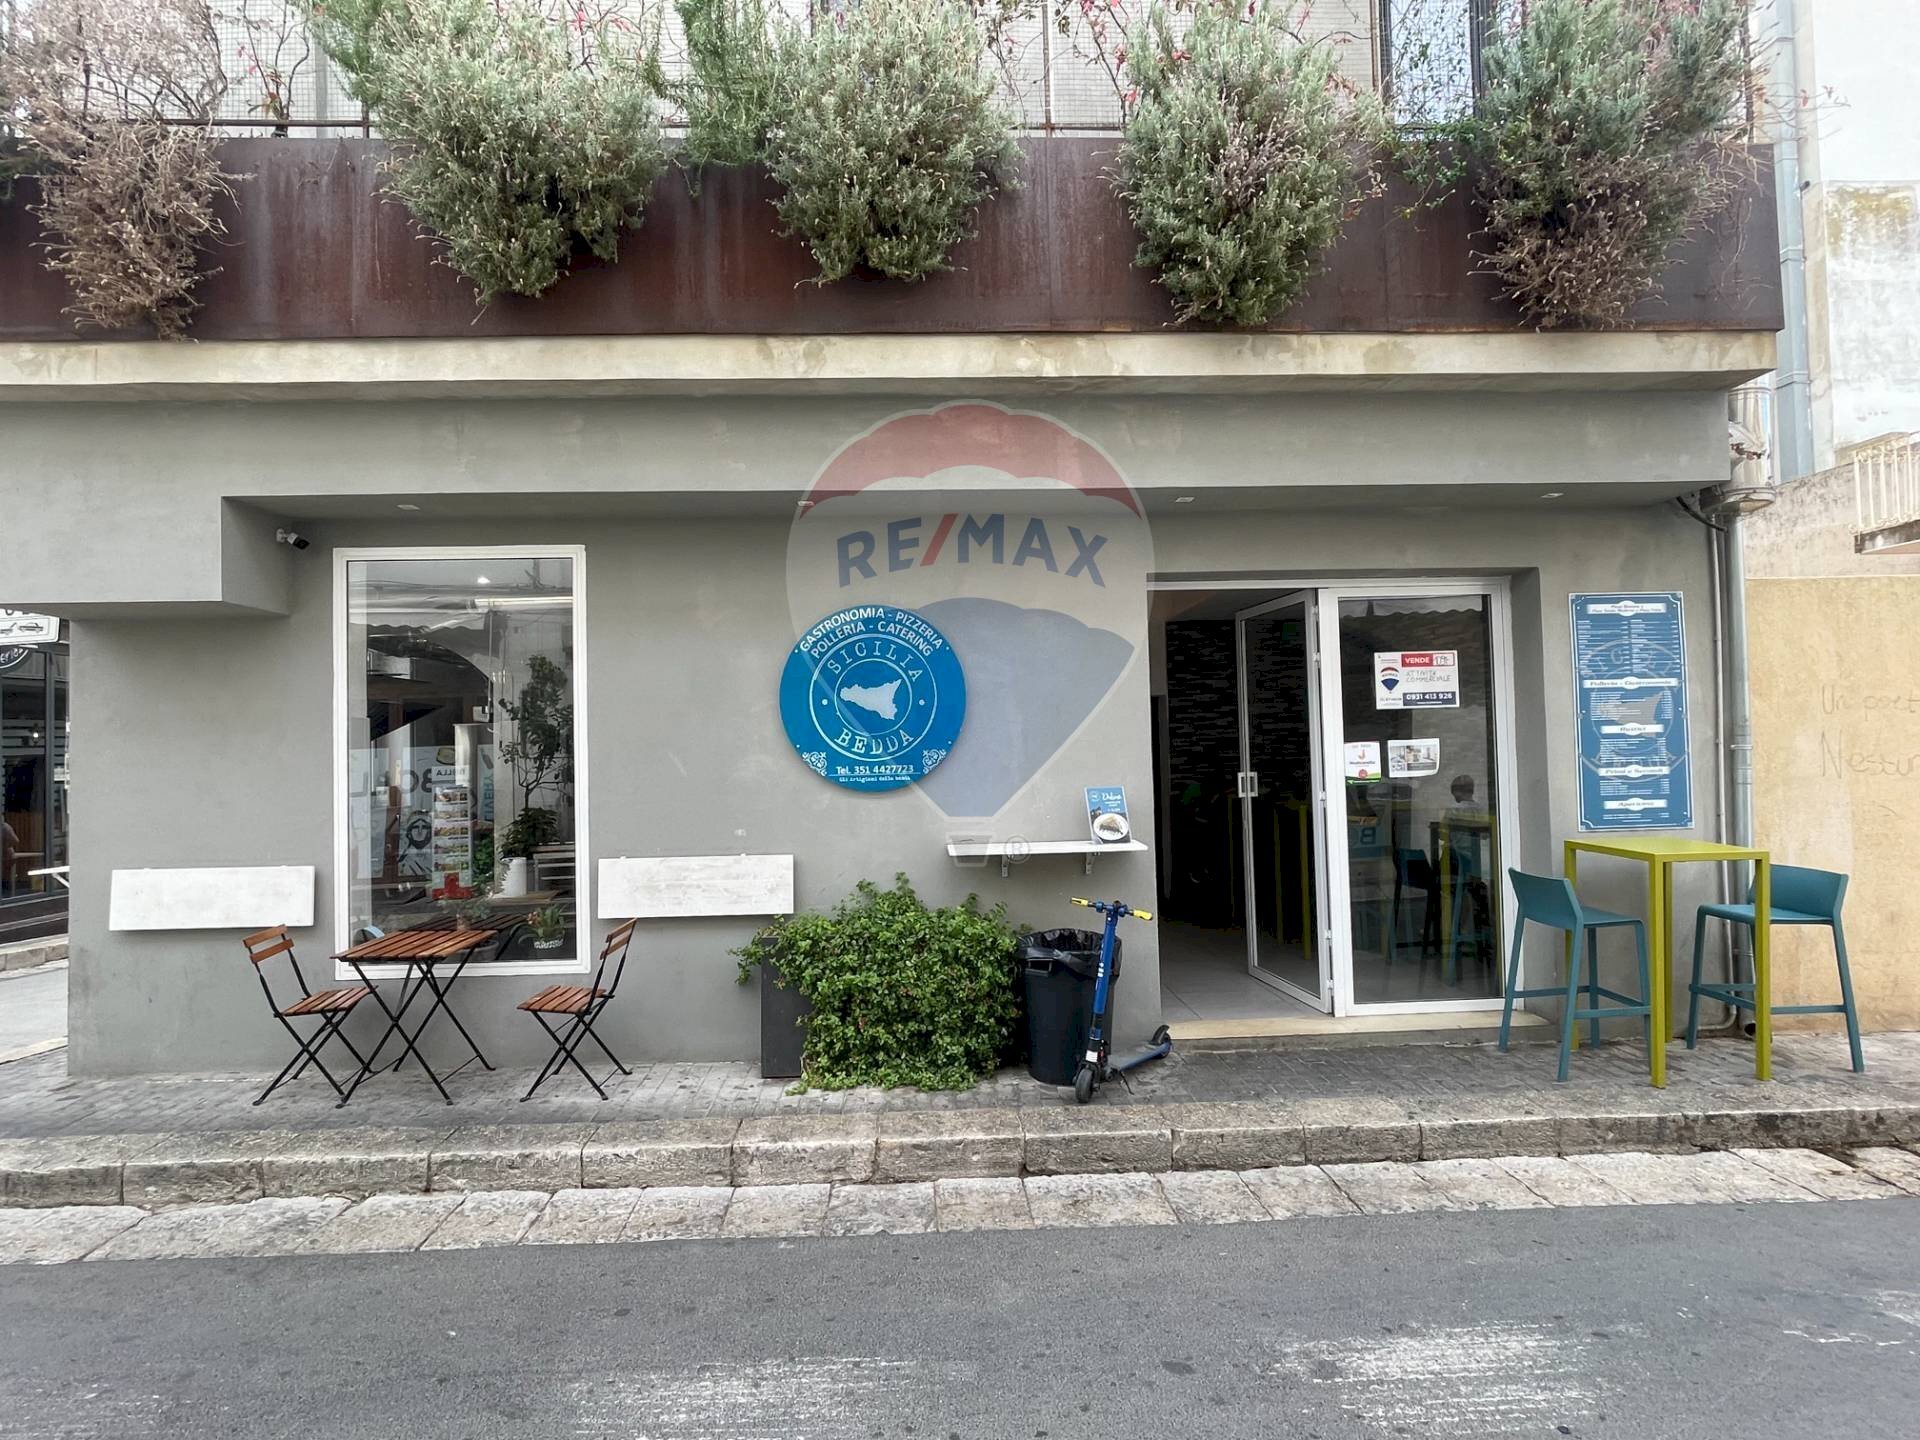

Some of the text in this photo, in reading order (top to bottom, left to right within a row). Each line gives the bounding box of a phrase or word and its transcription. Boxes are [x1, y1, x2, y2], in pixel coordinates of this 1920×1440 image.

[800, 607, 884, 652] GASTRONOMIA
[896, 612, 943, 649] PIZZERIA
[811, 622, 865, 659] POLLERIA
[878, 621, 933, 656] CATERING
[828, 641, 923, 682] SICILIA
[1404, 656, 1430, 664] VENDE
[834, 729, 914, 754] BEDDA
[854, 765, 870, 774] 351
[873, 765, 914, 775] 4427723
